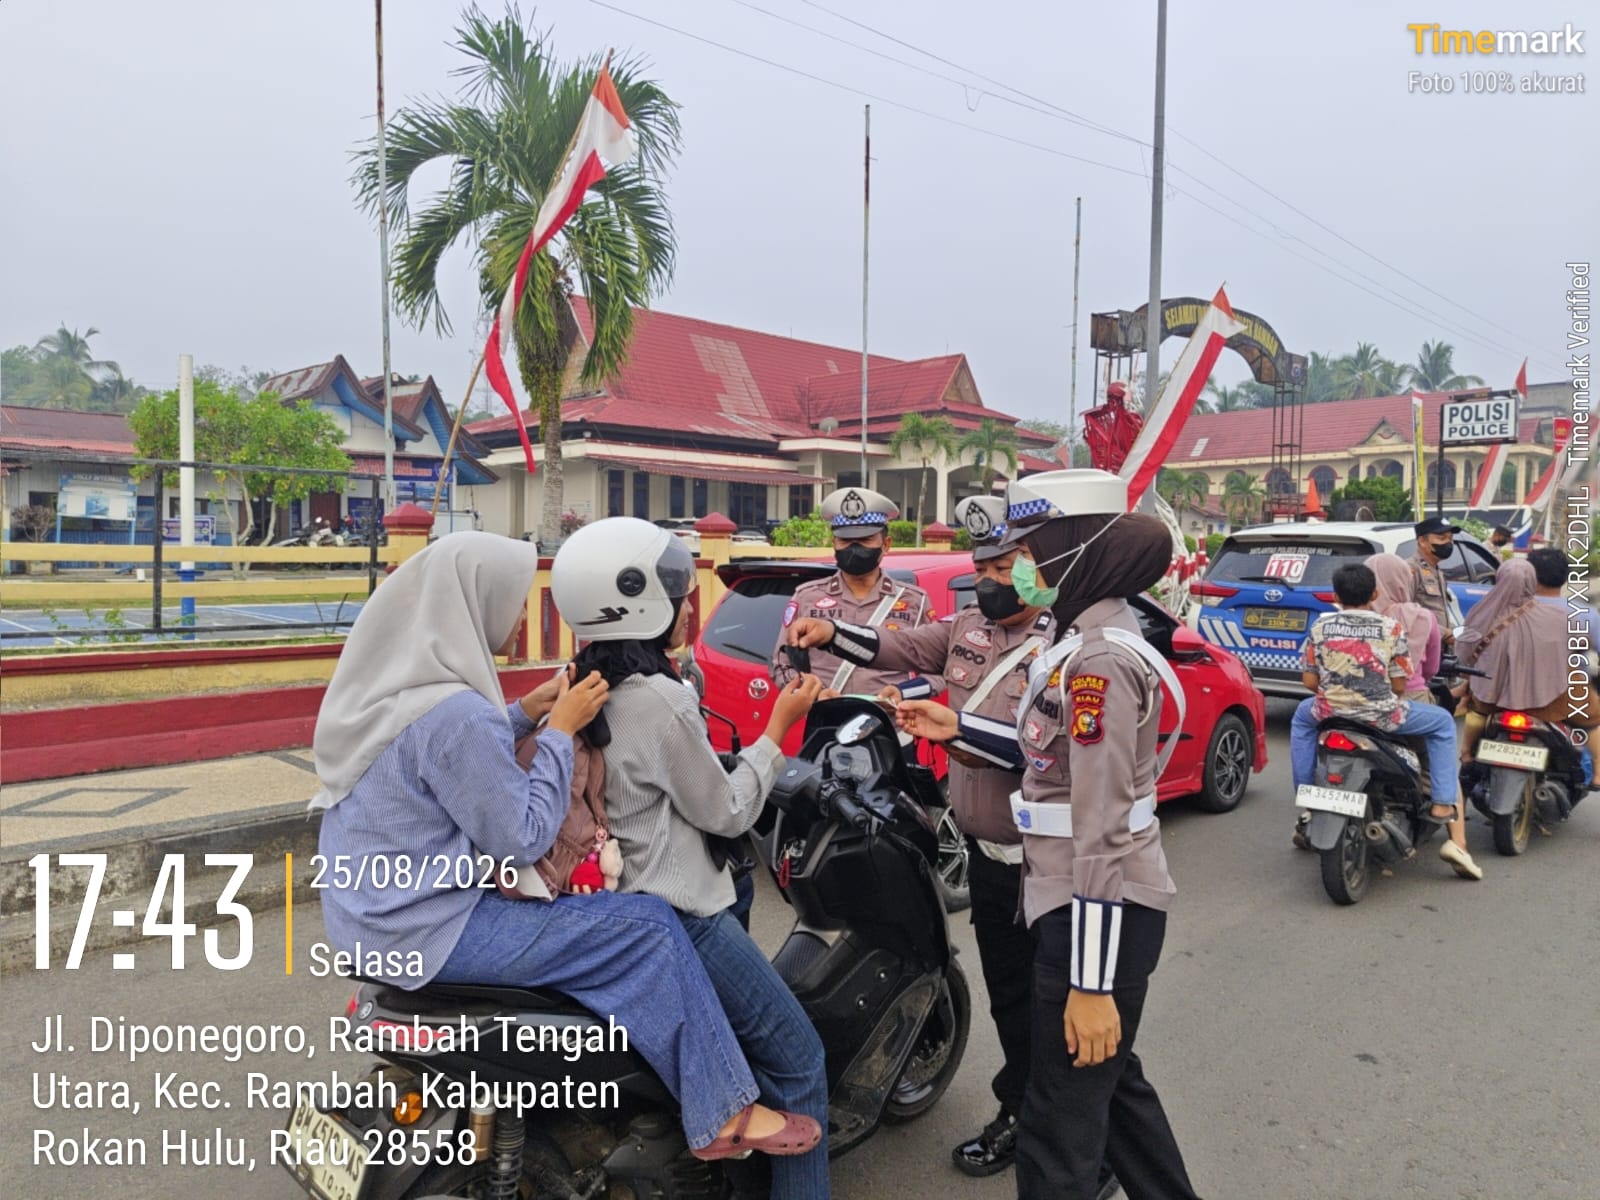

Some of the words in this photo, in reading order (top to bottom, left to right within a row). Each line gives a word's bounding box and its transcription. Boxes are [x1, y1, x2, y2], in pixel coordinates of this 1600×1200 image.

[1449, 402, 1509, 424] POLISI
[1448, 423, 1508, 438] POLICE
[1269, 560, 1304, 577] 110
[810, 609, 842, 618] ELVI
[1323, 623, 1381, 638] BOMBOOGIE
[1250, 637, 1297, 650] POLISI
[951, 644, 986, 665] RICO
[1075, 695, 1100, 704] RIAU
